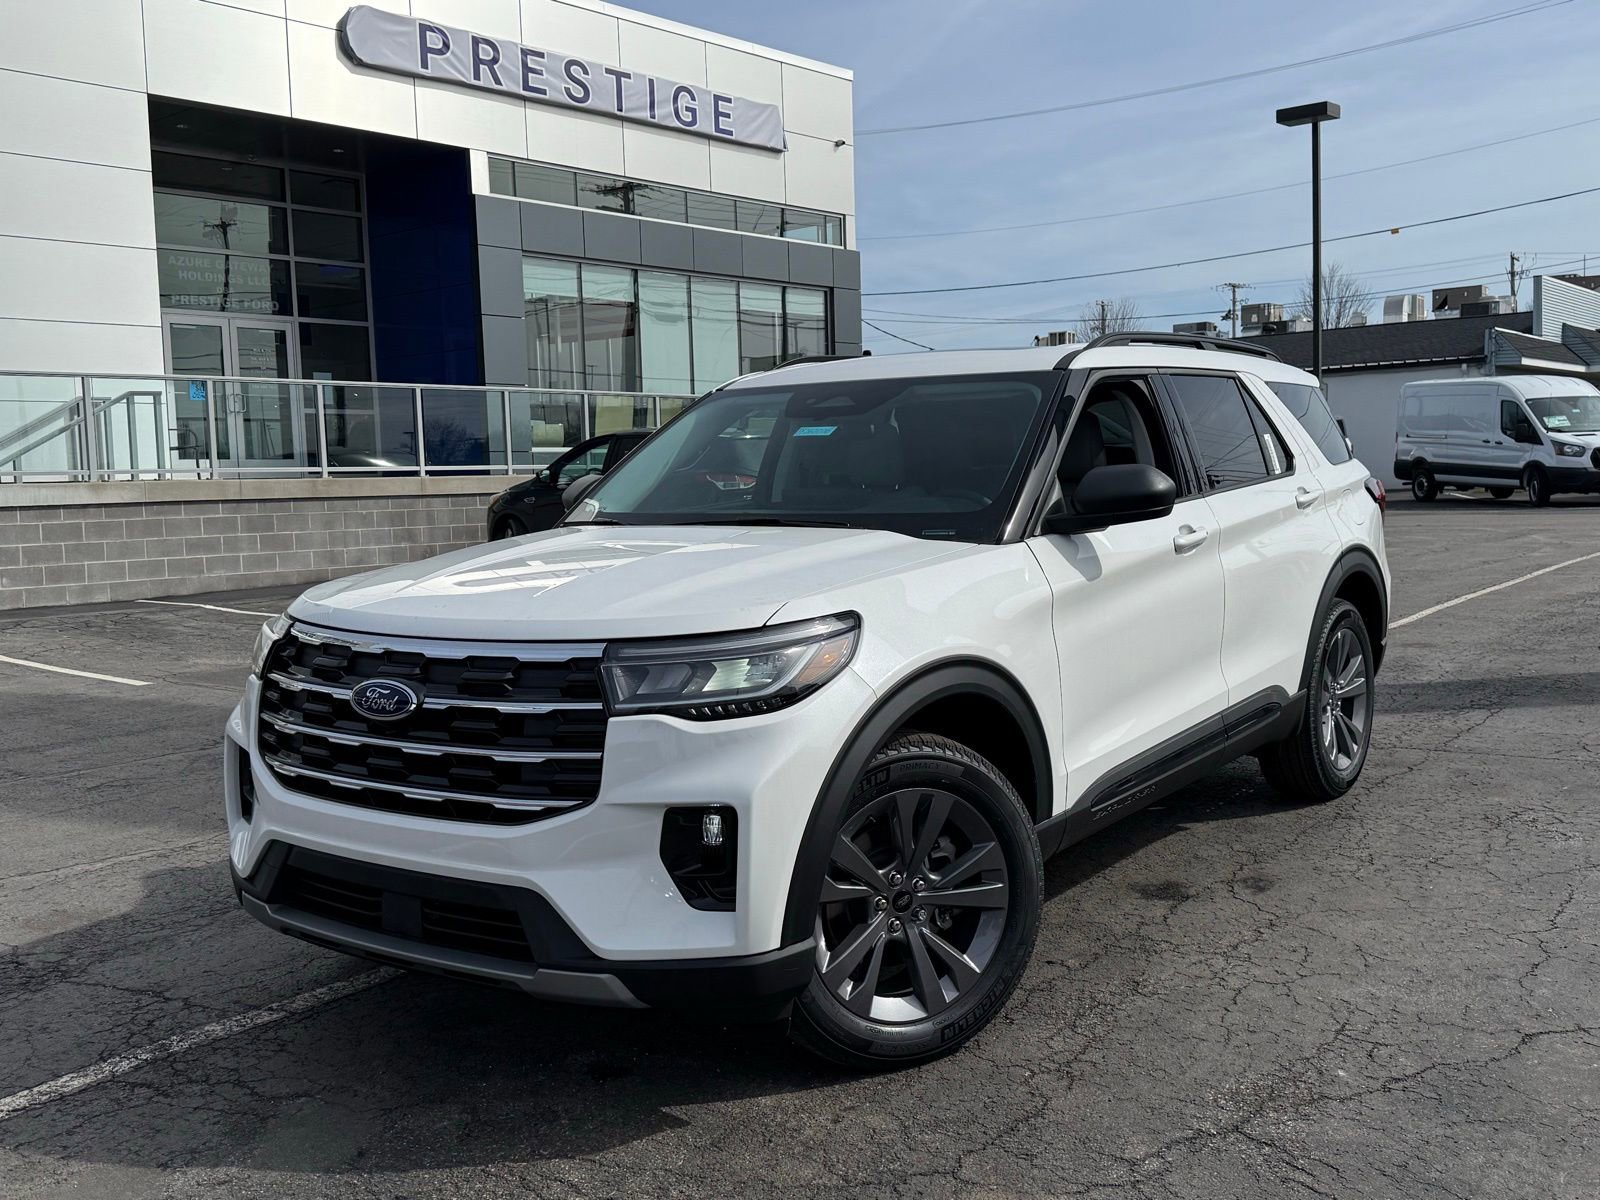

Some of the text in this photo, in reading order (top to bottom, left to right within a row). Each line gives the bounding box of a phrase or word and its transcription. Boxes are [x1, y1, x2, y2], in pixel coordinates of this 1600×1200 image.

[417, 21, 736, 138] PRESTIGE
[168, 256, 210, 268] AZURE
[178, 270, 243, 285] HOLDINGS
[171, 295, 280, 312] PRESTIGE FORD
[361, 686, 399, 711] Ford
[943, 977, 1006, 1041] MICHELIN
